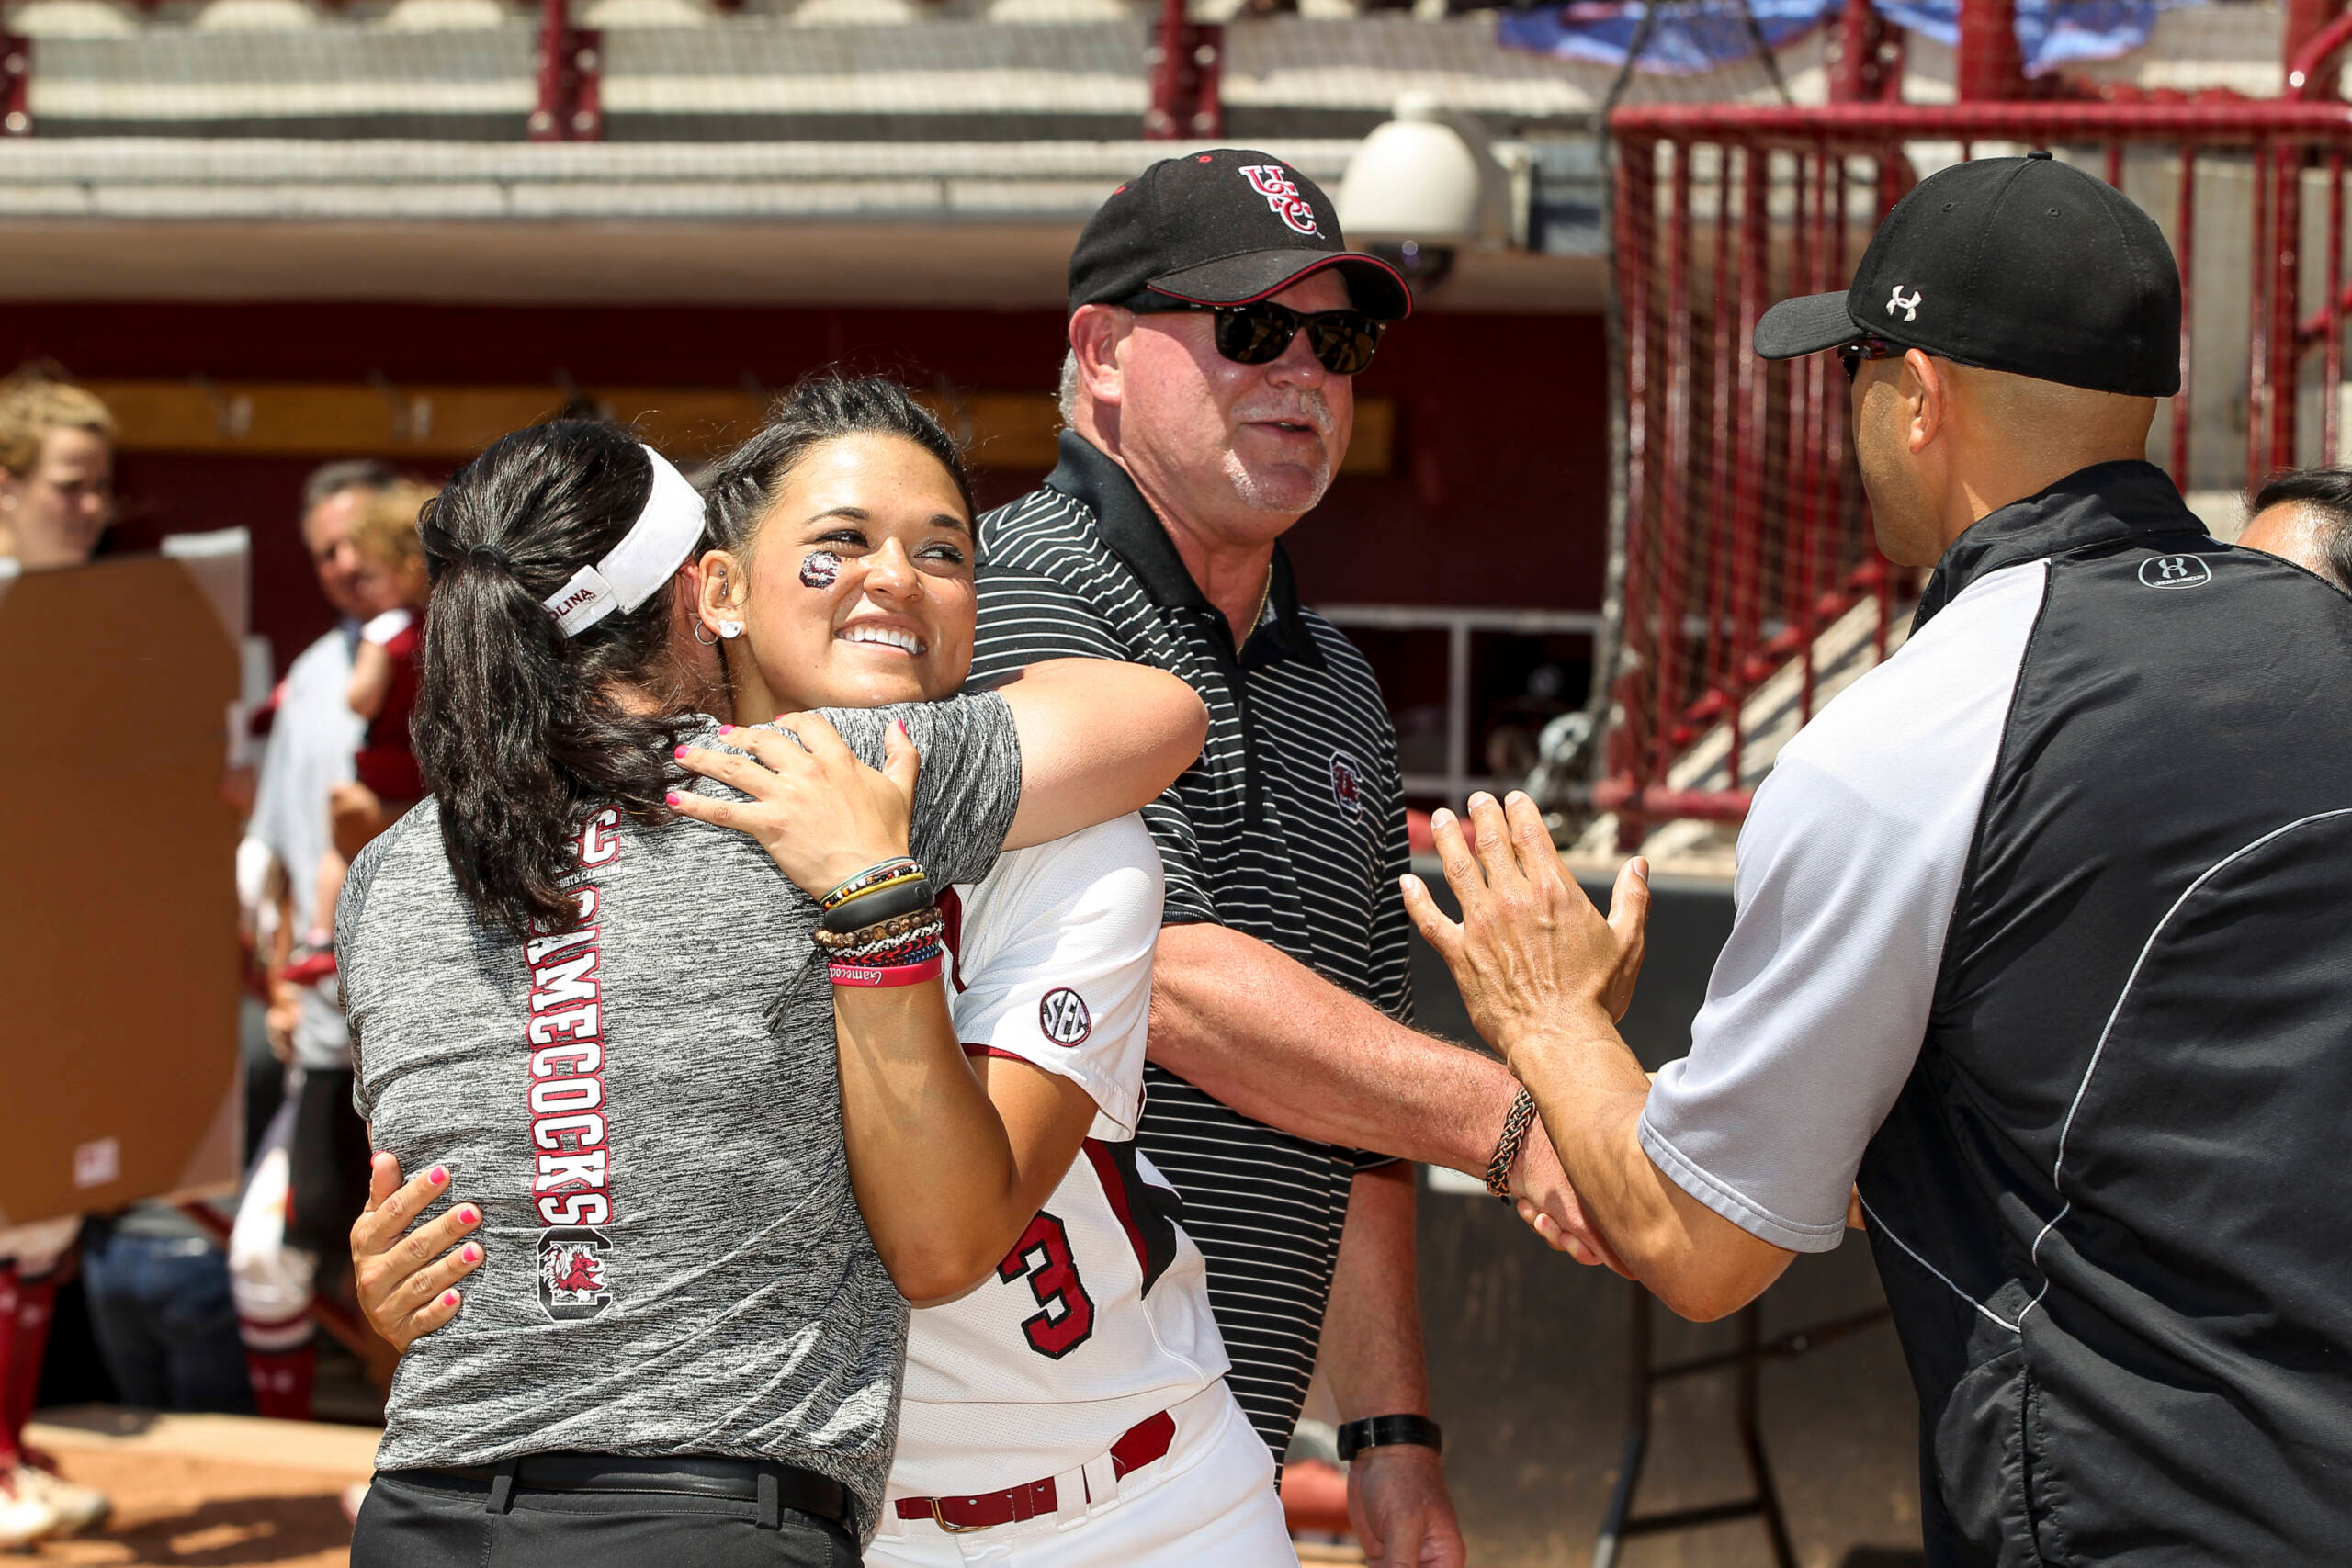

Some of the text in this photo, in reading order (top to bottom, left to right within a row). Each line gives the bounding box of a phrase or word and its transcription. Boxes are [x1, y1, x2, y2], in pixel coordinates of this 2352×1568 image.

[1238, 165, 1317, 235] USC
[1043, 990, 1088, 1043] SEC
[996, 1209, 1095, 1360] 3
